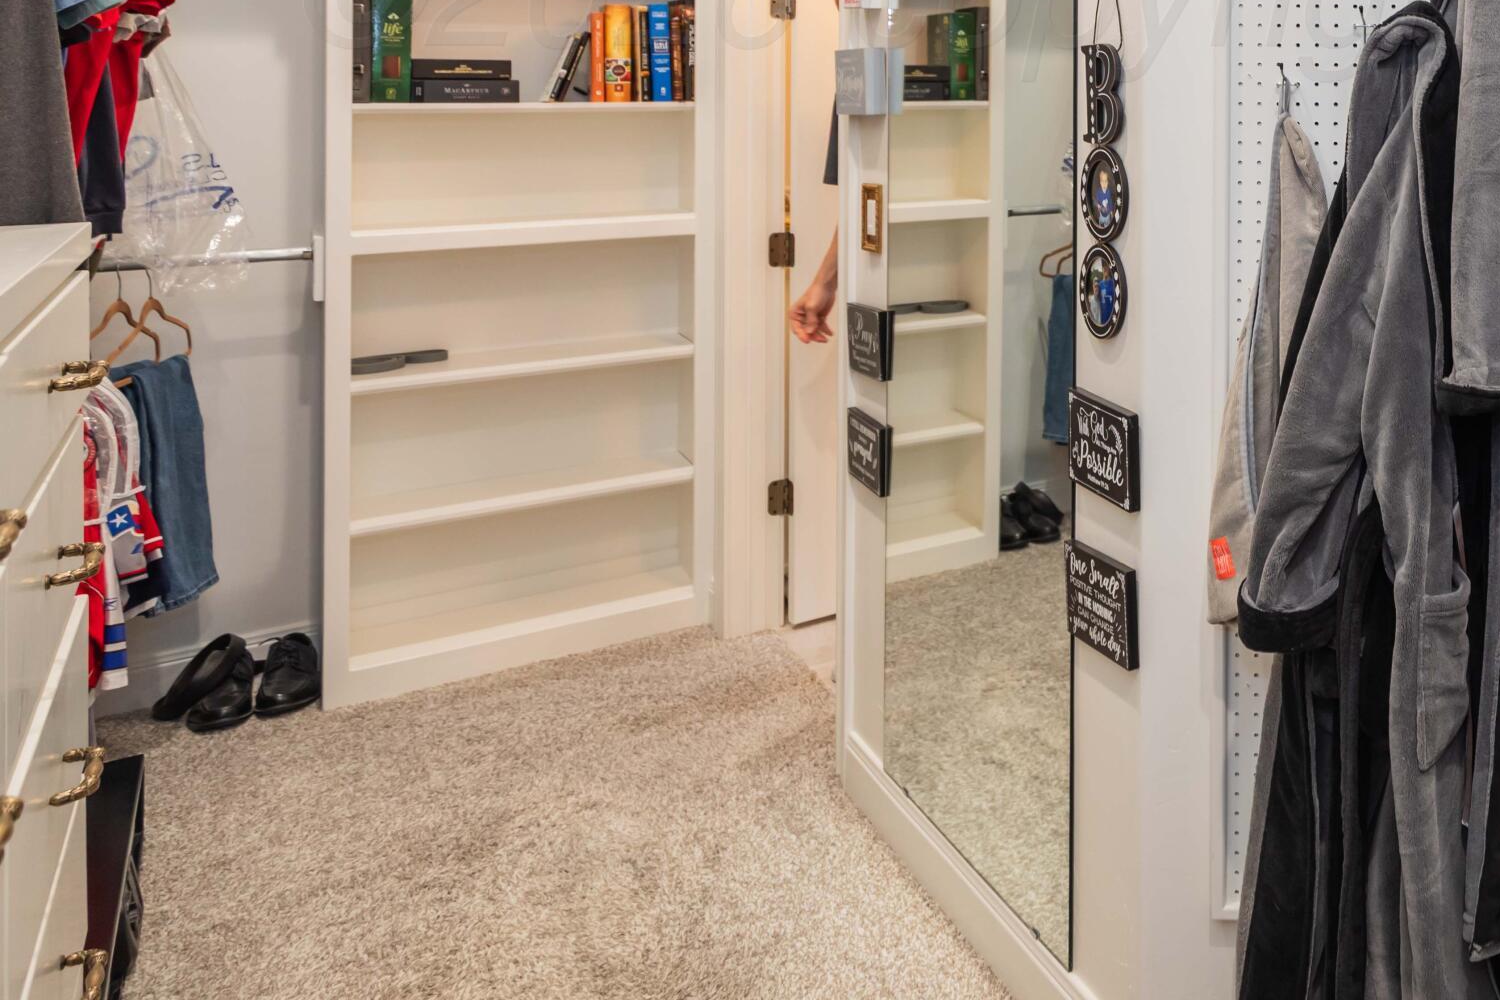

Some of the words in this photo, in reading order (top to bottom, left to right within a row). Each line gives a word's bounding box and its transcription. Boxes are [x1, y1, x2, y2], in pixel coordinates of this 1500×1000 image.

[383, 22, 403, 36] life
[1090, 411, 1108, 444] God
[1077, 439, 1123, 486] Possible
[1070, 552, 1087, 575] One
[1089, 559, 1119, 599] Small
[1070, 575, 1093, 596] POSITIVE
[1094, 588, 1121, 612] THOUGHT
[1083, 594, 1092, 610] THE
[1092, 600, 1113, 623] MORNING
[1078, 605, 1089, 620] CAN
[1090, 612, 1114, 635] CHANGE
[1073, 616, 1088, 633] your
[1089, 625, 1107, 645] whole
[1108, 636, 1121, 661] day
